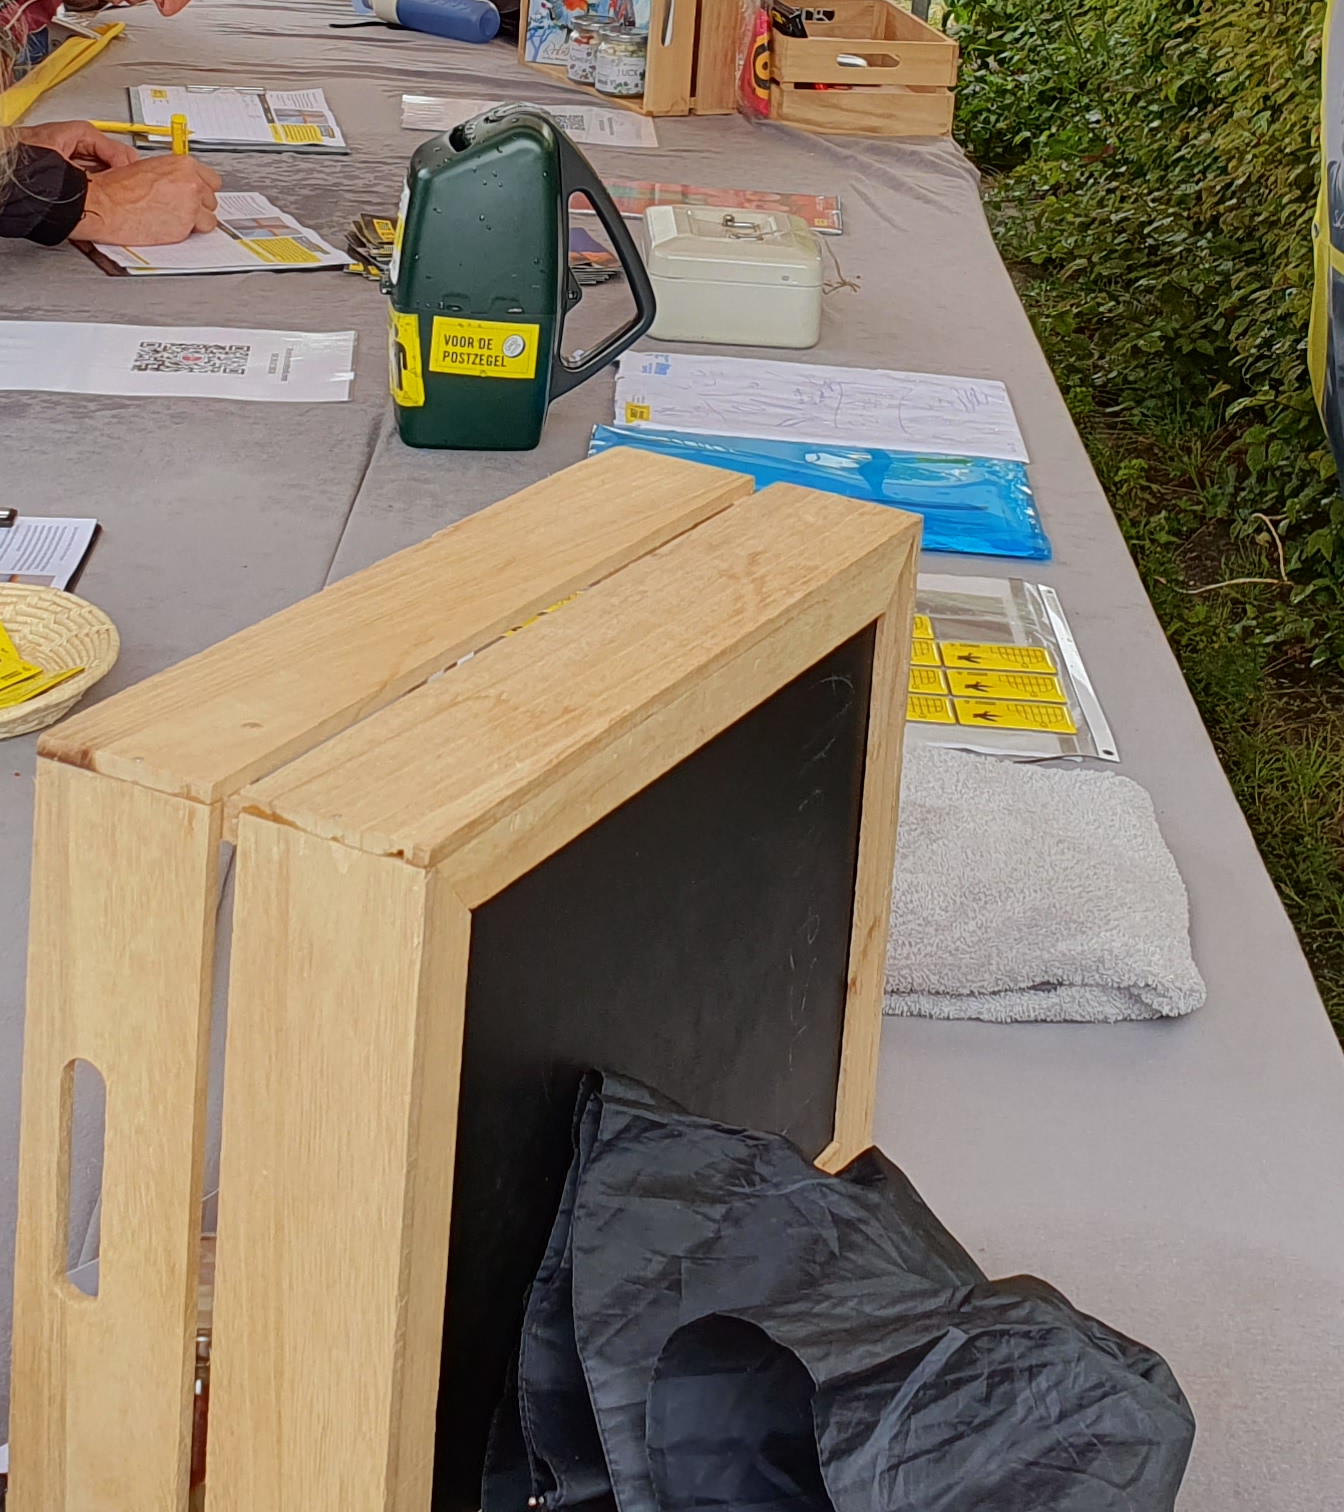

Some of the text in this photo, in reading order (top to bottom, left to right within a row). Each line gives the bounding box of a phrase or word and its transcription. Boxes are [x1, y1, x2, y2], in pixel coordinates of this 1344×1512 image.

[443, 333, 494, 350] VOOR DE
[442, 350, 508, 368] POSTZEGEL
